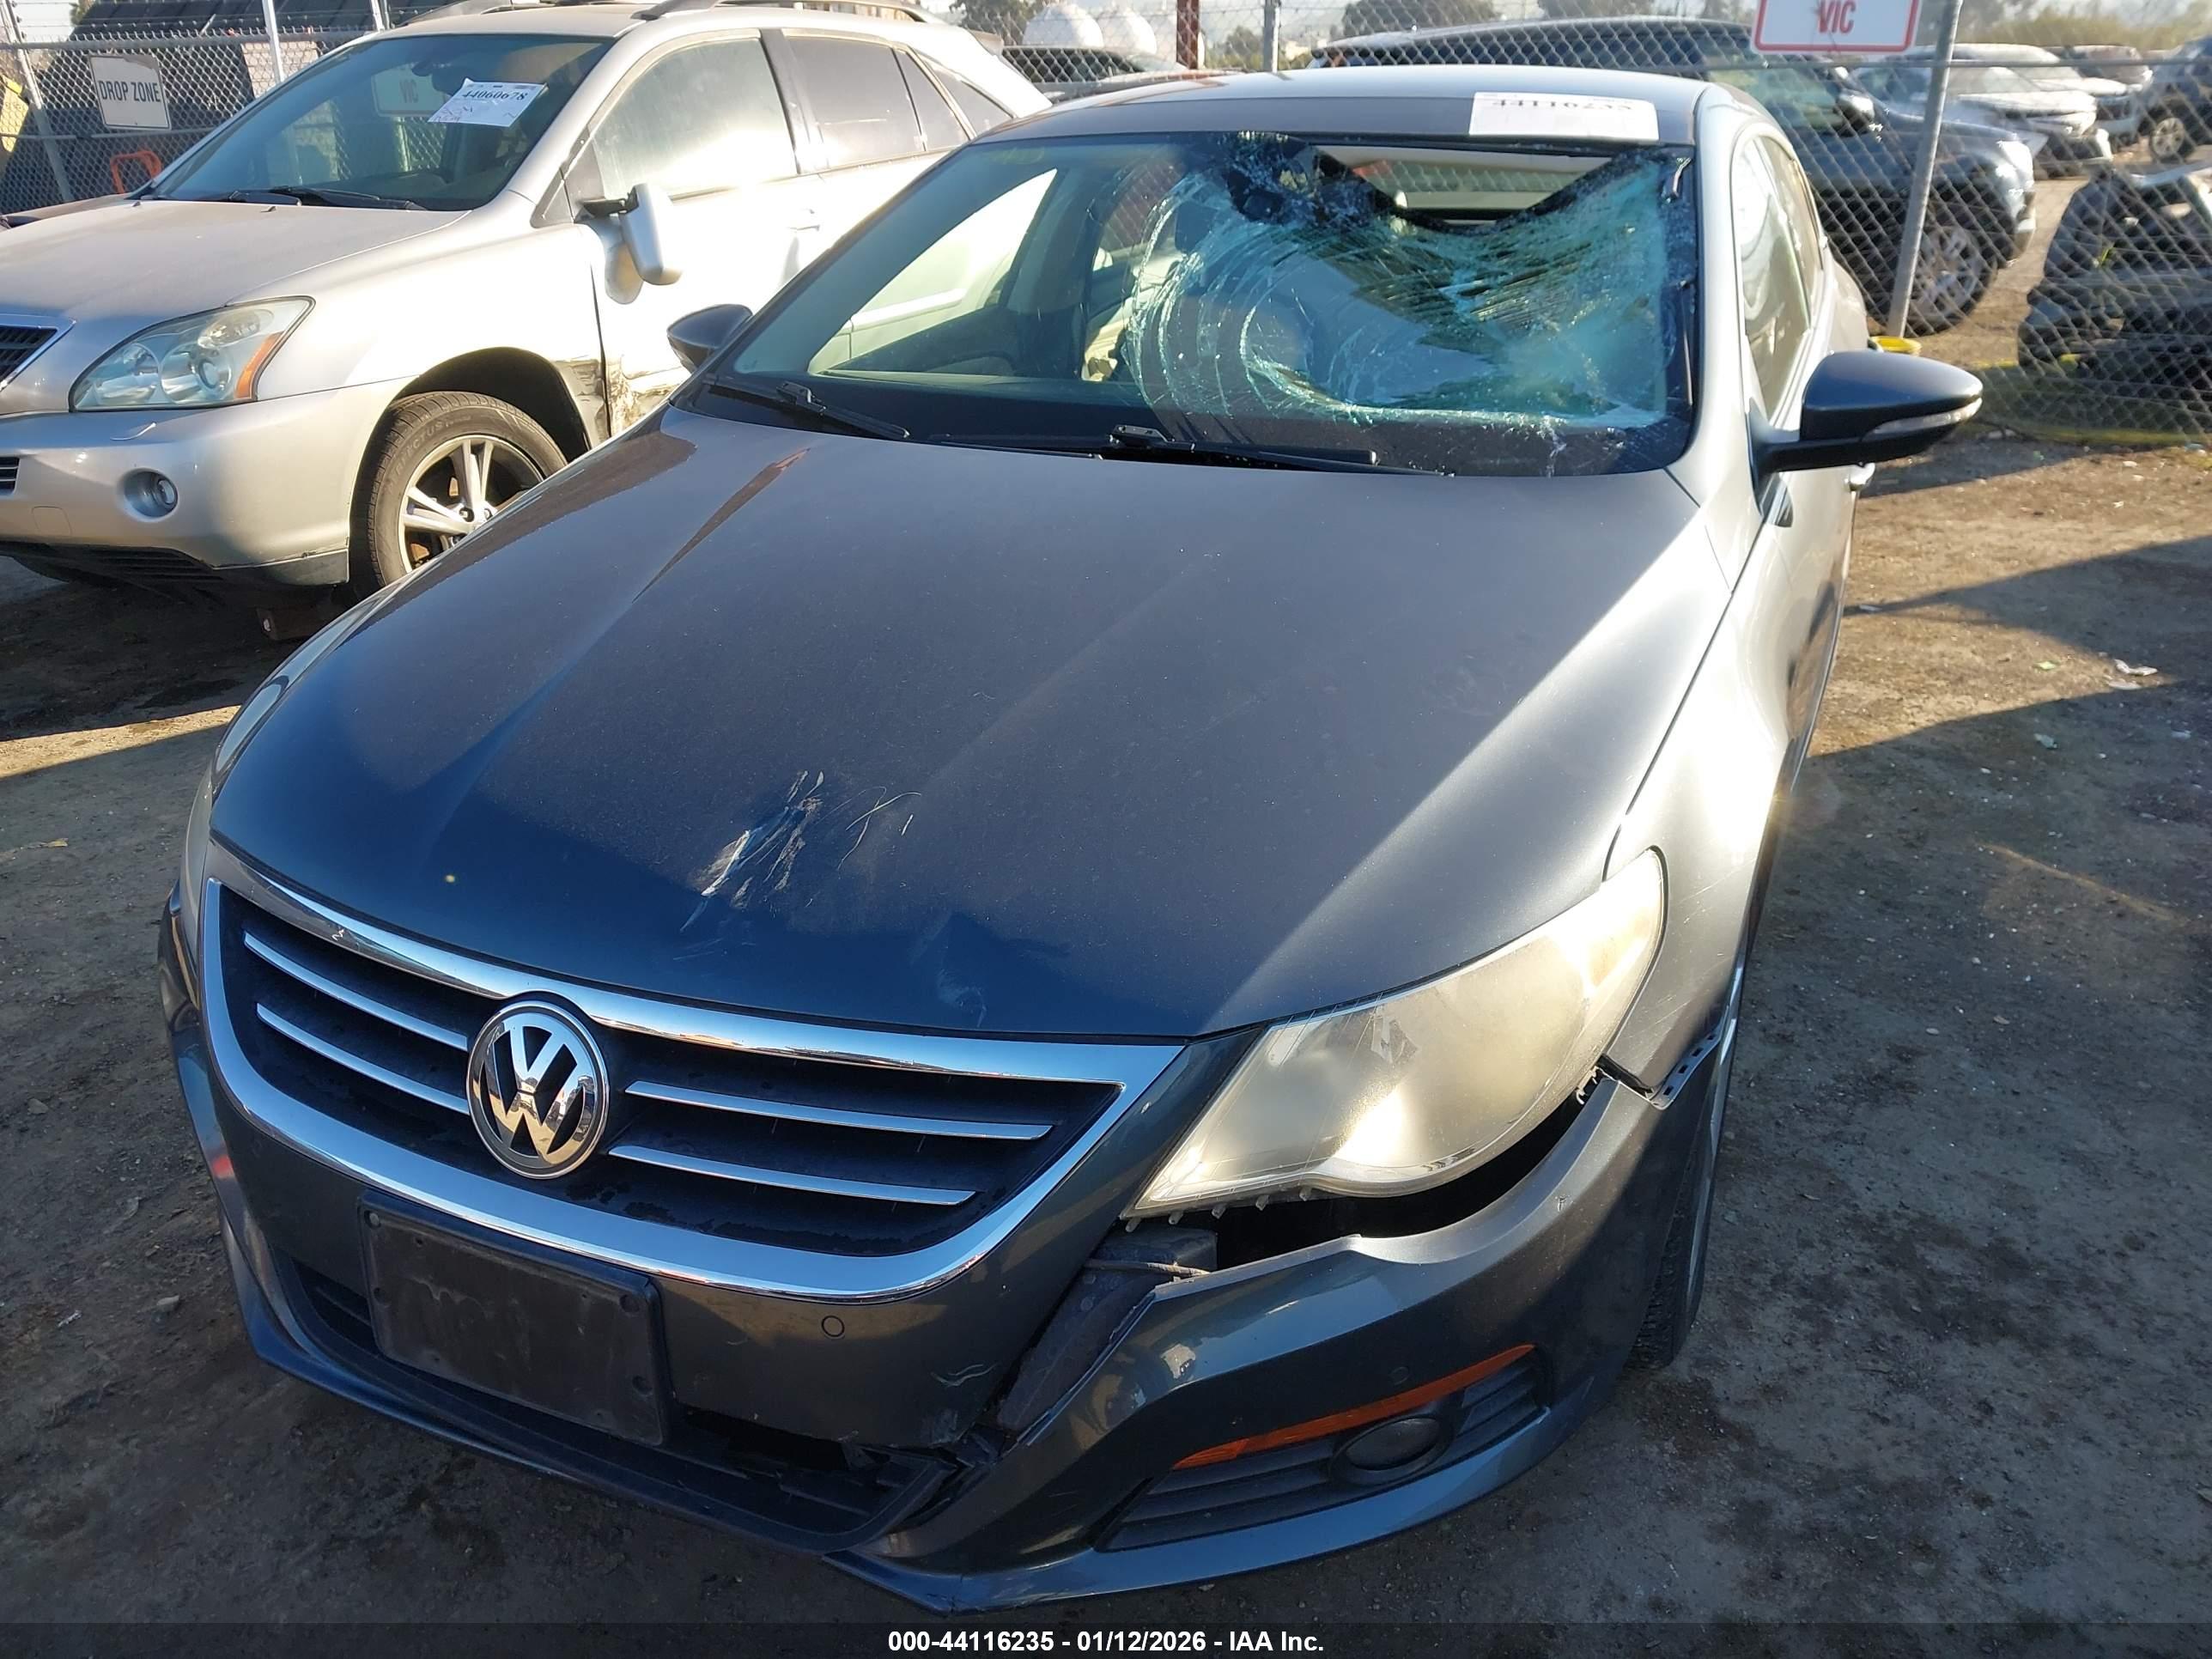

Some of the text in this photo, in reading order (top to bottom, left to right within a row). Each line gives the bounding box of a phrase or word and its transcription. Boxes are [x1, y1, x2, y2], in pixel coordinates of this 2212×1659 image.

[1818, 0, 1856, 33] VIC
[98, 81, 161, 103] DROP ZONE
[462, 89, 529, 100] 44060678
